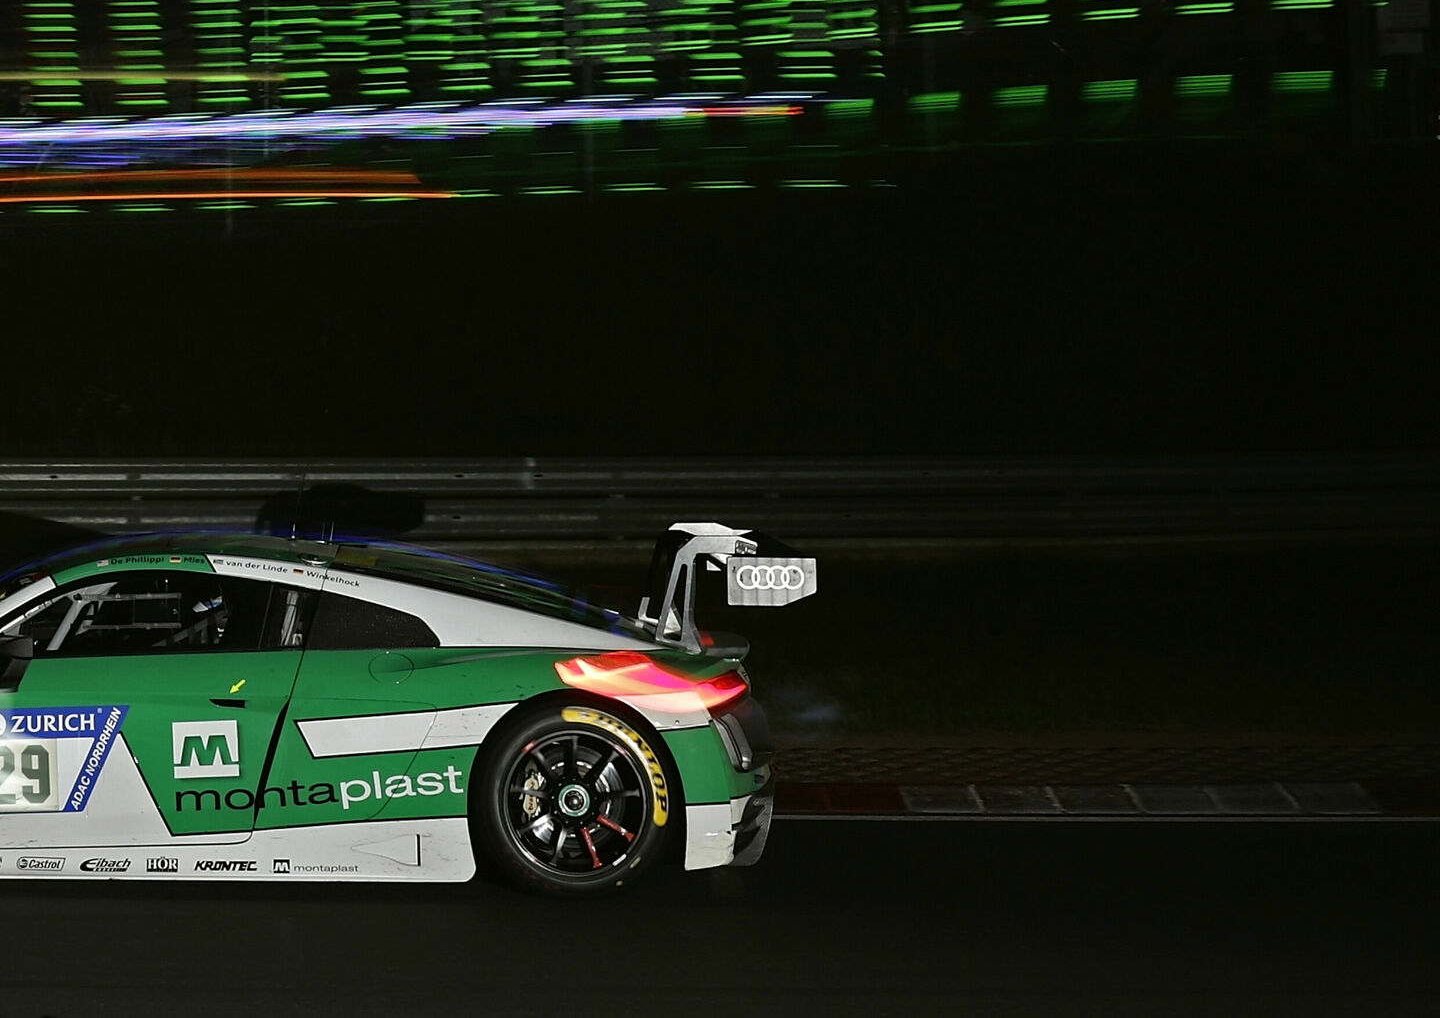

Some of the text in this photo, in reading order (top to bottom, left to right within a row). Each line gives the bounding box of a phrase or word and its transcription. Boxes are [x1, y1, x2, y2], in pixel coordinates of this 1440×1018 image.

[263, 564, 288, 573] Linde
[307, 570, 360, 587] Winkelhock
[11, 714, 95, 733] ZURICH
[71, 706, 122, 810] ADAC NORDRHEIN
[175, 765, 464, 812] montaplast
[29, 859, 61, 869] Castrol
[80, 858, 131, 872] Eibach
[194, 860, 258, 871] KRONTEC
[294, 863, 359, 873] montaplast
